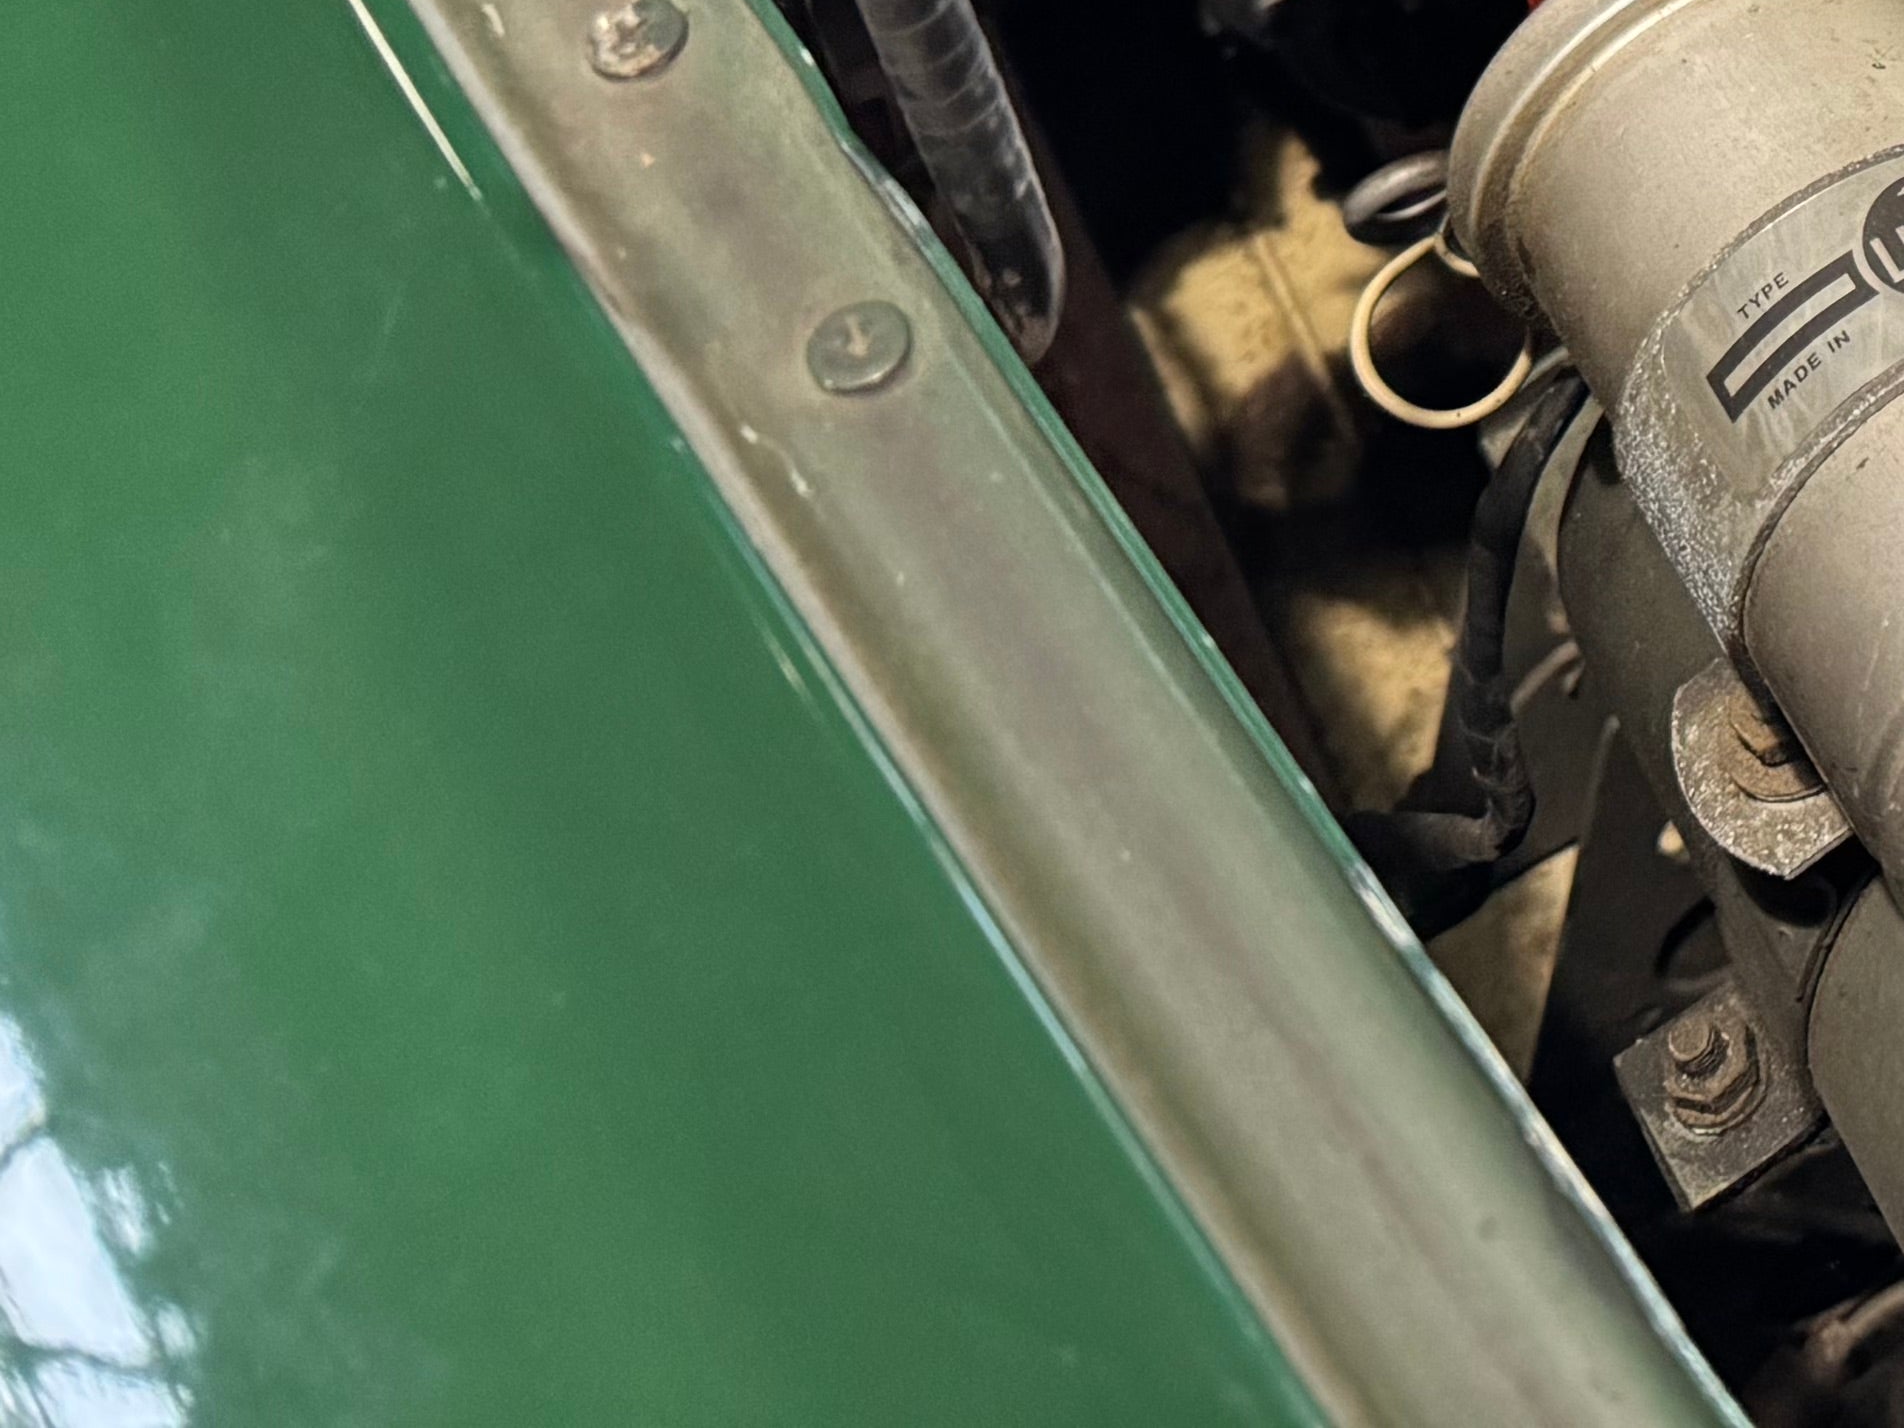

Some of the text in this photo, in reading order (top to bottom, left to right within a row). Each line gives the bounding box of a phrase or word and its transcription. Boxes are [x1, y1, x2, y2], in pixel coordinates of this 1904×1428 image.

[1736, 271, 1789, 319] TYPE
[1767, 329, 1851, 410] MADE IN
